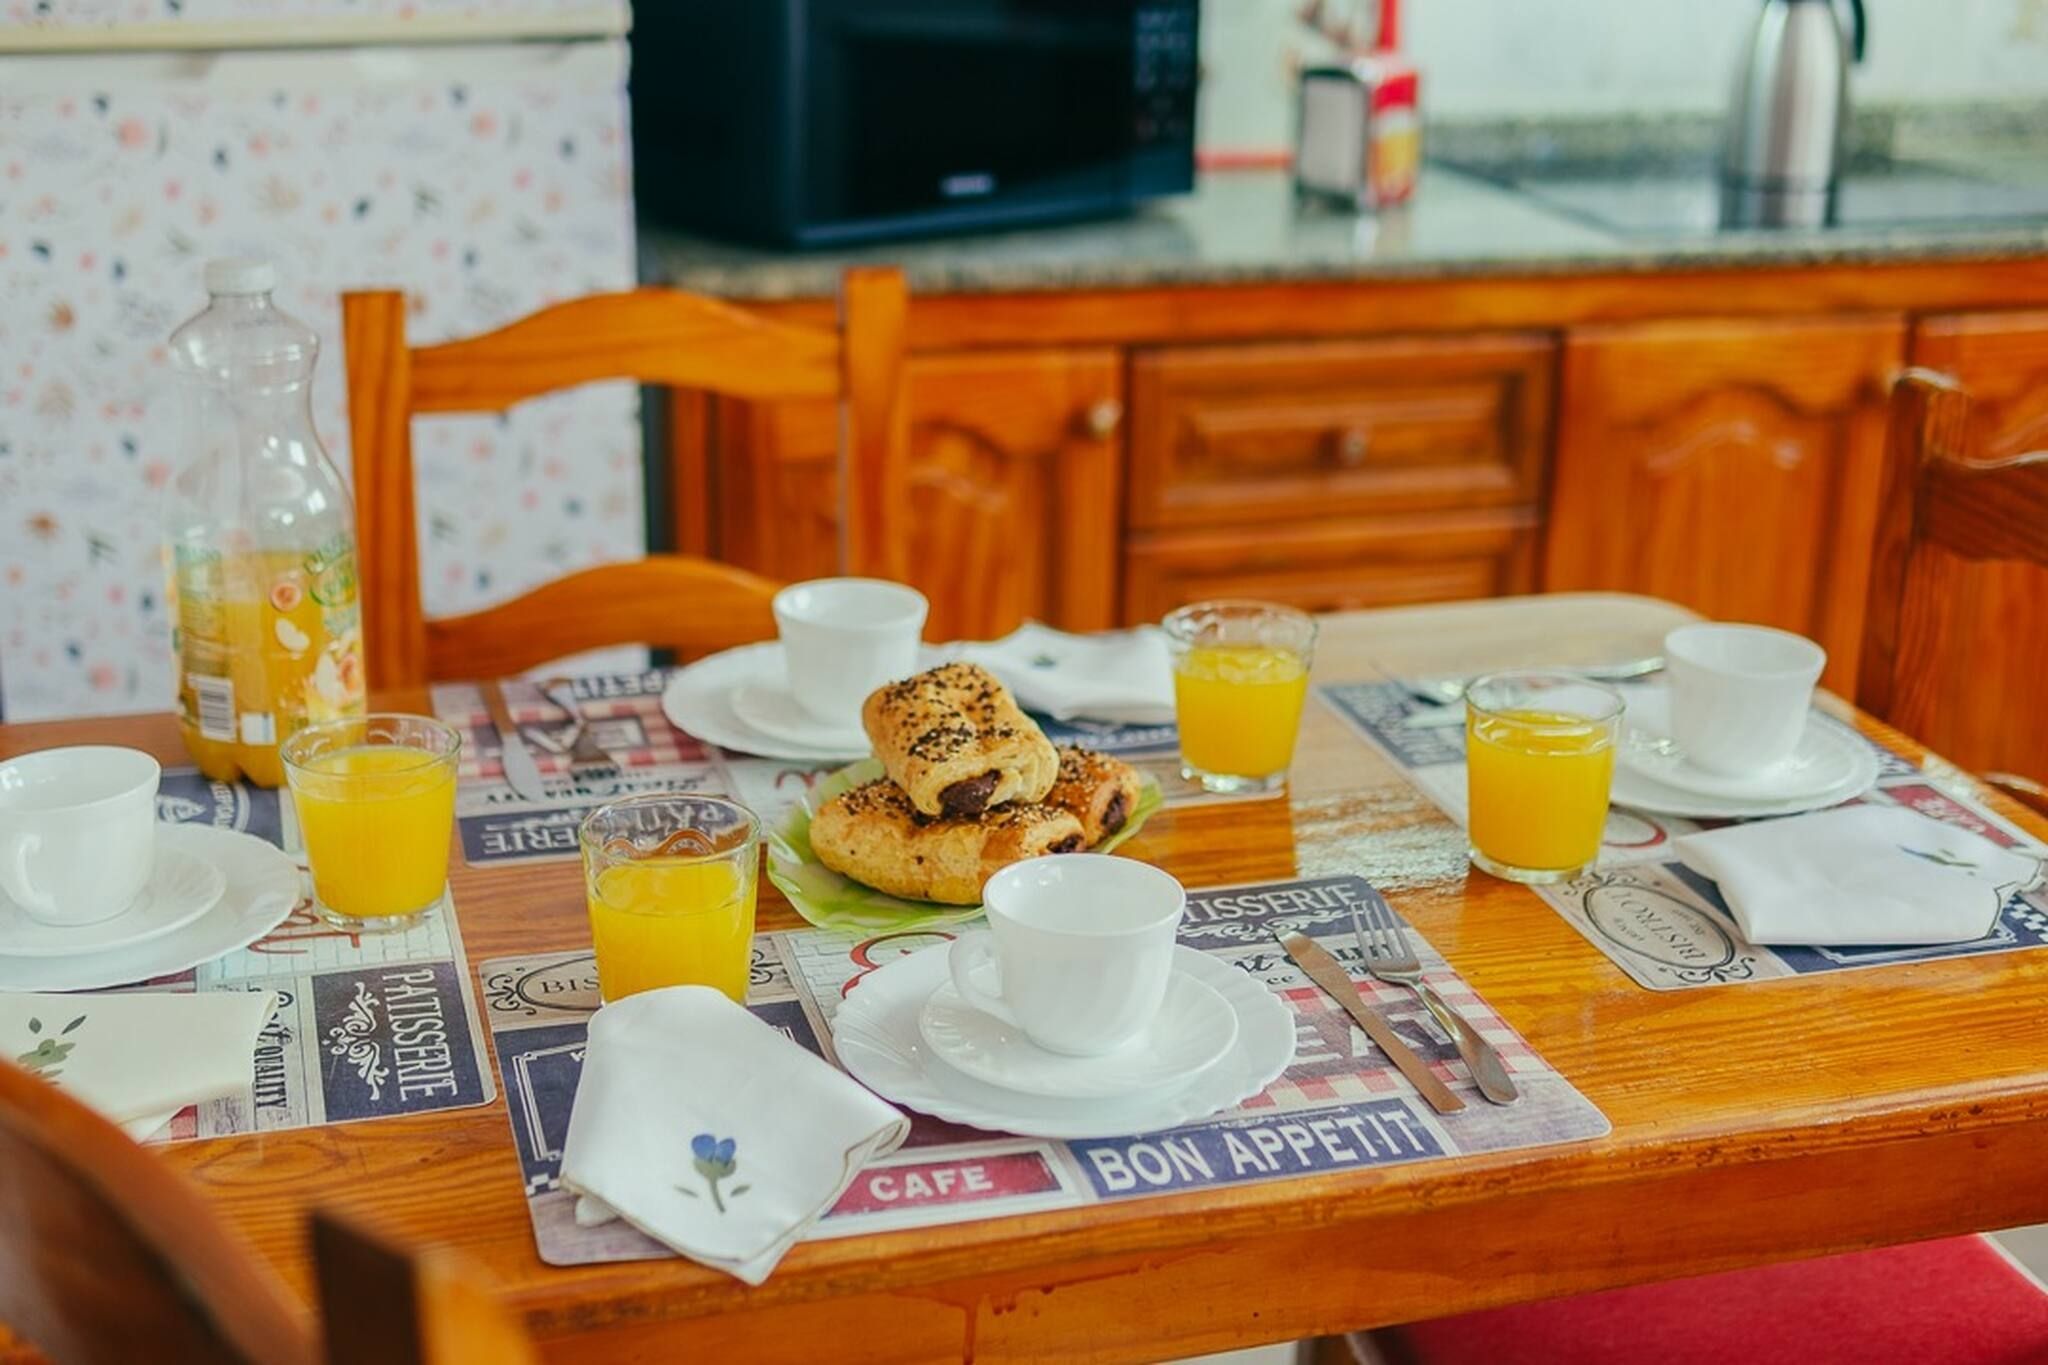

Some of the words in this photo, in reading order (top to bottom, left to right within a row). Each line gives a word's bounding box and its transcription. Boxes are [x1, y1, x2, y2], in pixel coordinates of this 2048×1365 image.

[1184, 883, 1357, 923] TISSERIE
[382, 967, 459, 1102] PATISSERIE
[254, 1046, 288, 1109] QUALITY
[1088, 1136, 1214, 1192] BON
[1222, 1111, 1425, 1175] APPETIT
[868, 1165, 994, 1202] CAFE
